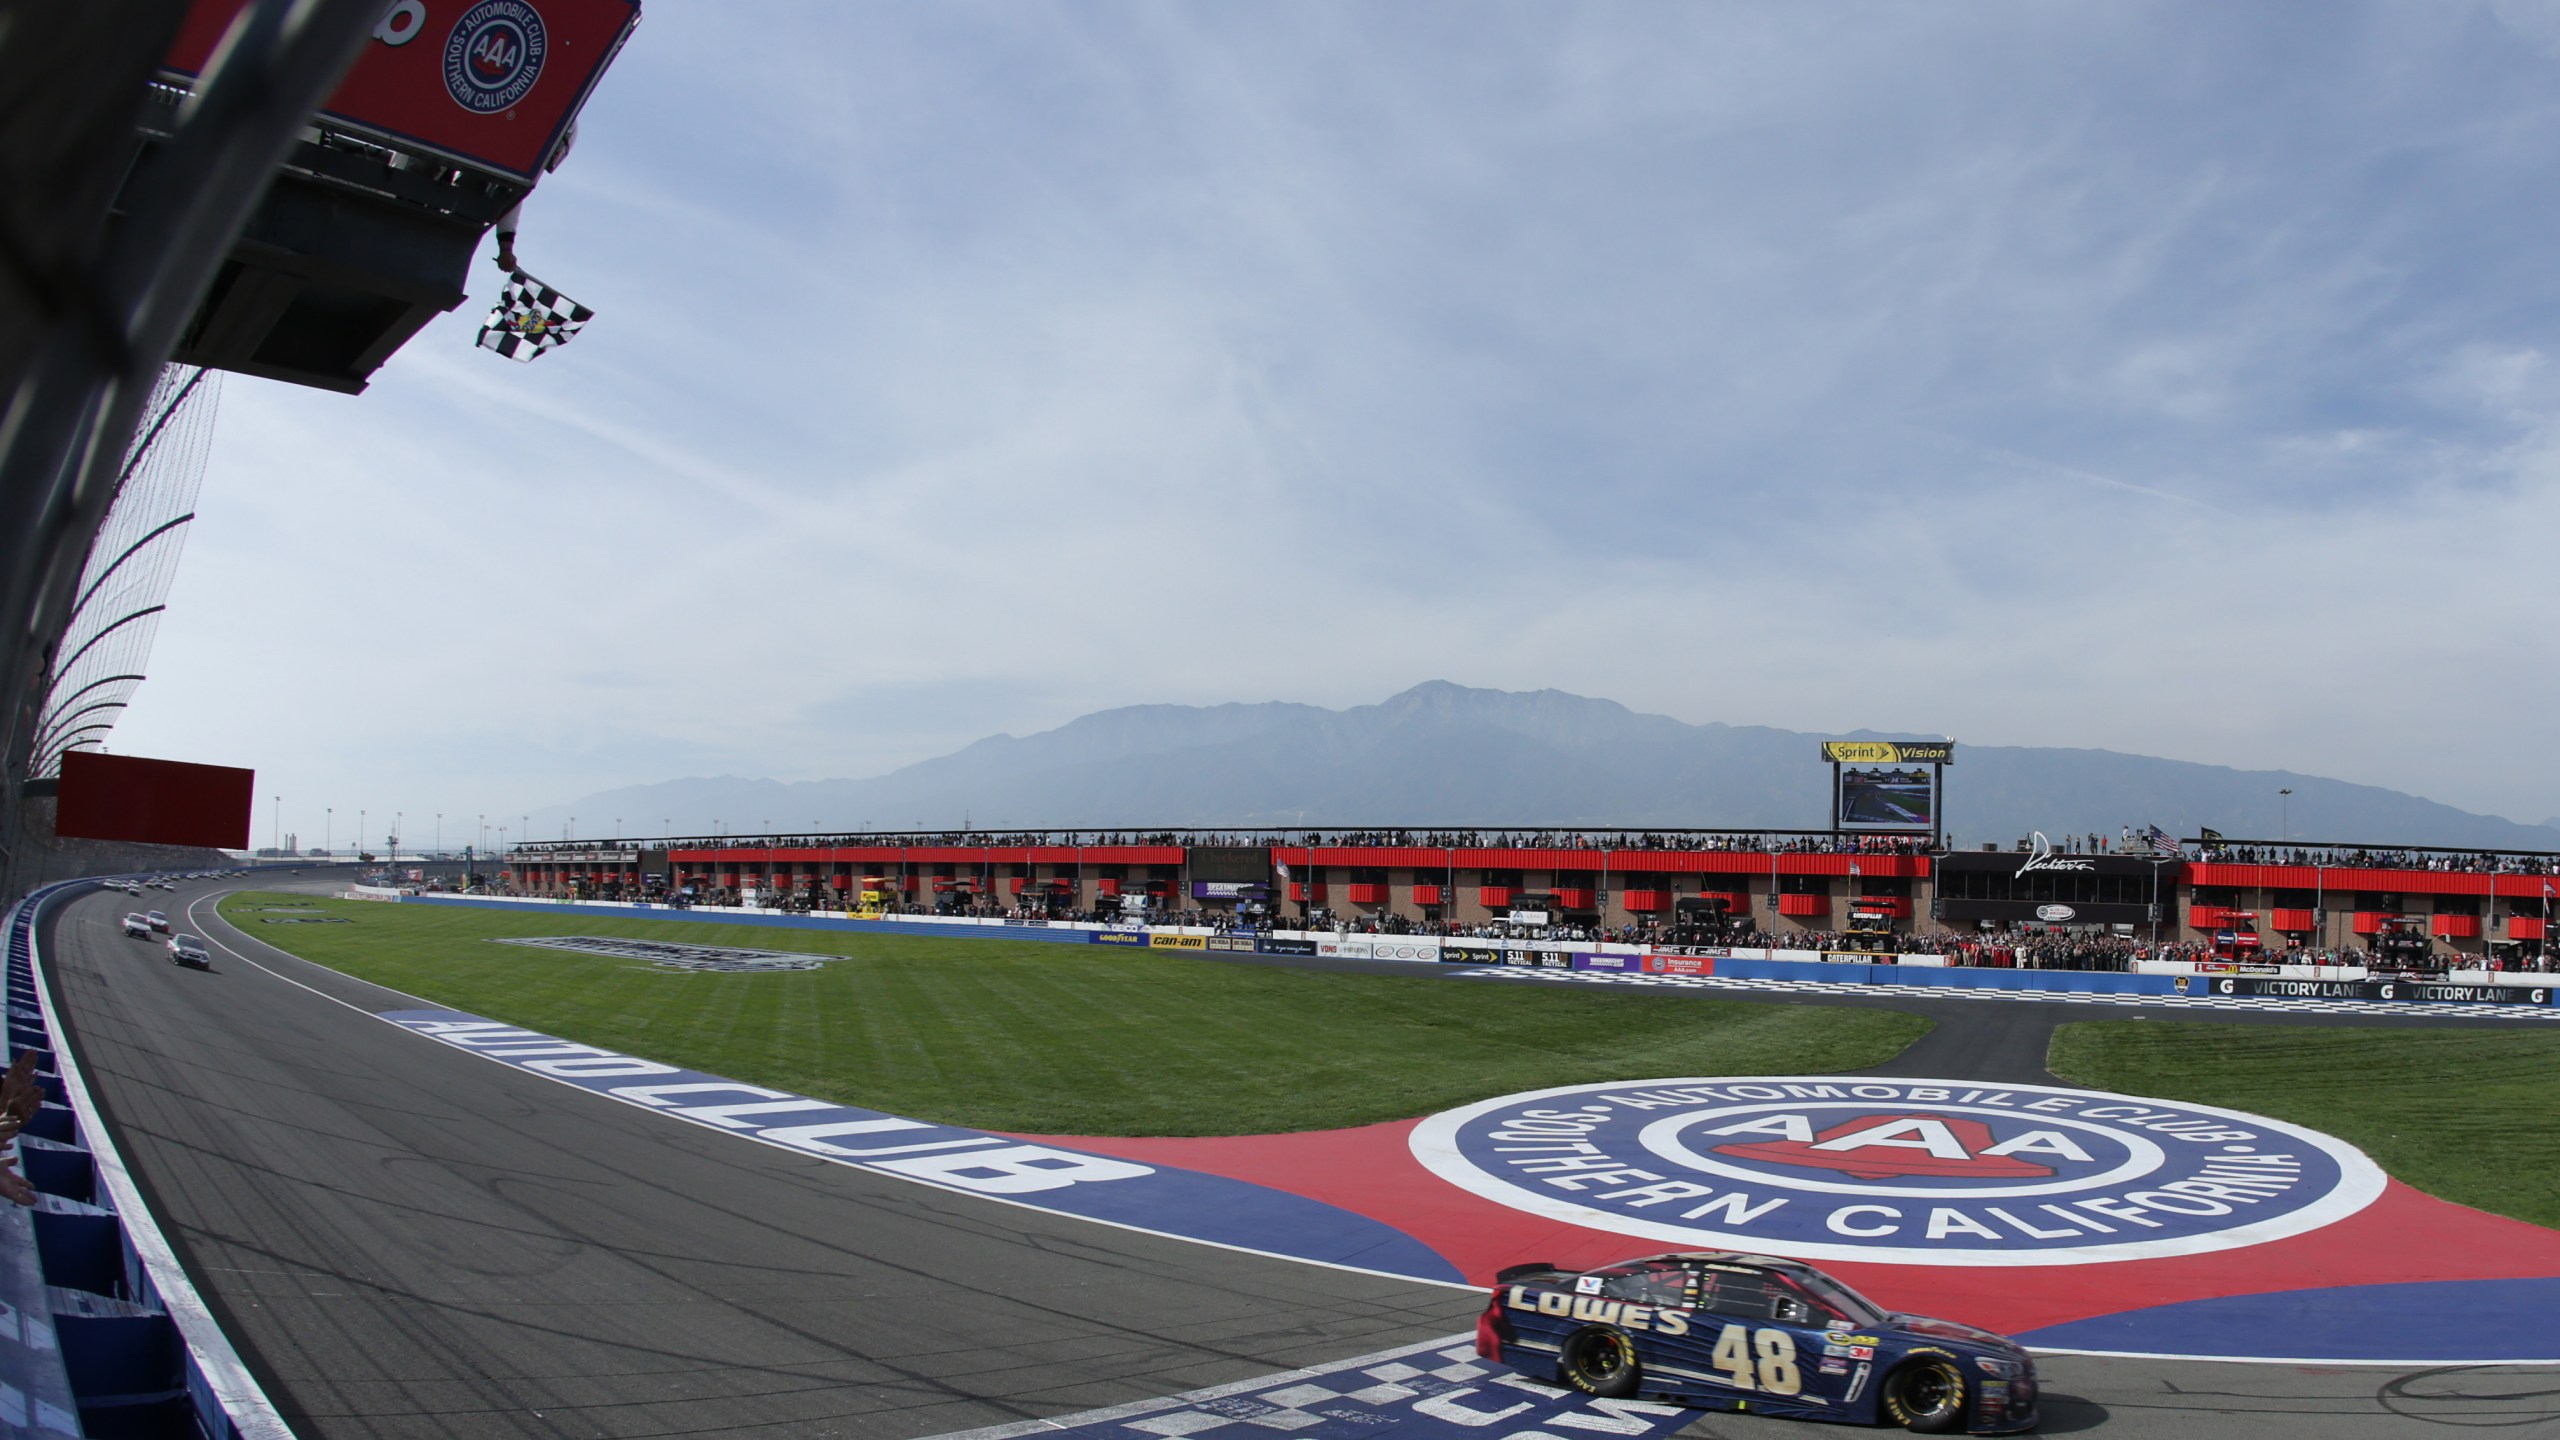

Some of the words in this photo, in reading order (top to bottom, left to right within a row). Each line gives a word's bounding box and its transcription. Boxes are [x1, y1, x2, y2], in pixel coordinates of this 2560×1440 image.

[466, 2, 532, 31] AUTOMOBILE
[527, 24, 541, 55] CLUB
[474, 35, 516, 67] AAA
[448, 35, 475, 103] SOUTHERN
[475, 67, 537, 108] CALIFORNIA
[1838, 747, 1875, 759] Sprint
[1901, 748, 1946, 758] Vision
[1099, 934, 1138, 943] GOODYEAR
[1320, 945, 1337, 953] VONS
[1443, 951, 1461, 960] Sprint
[1472, 953, 1489, 961] Sprint
[1507, 951, 1524, 960] 5.11
[1541, 953, 1559, 962] 5.11
[1668, 958, 1702, 966] Insurance
[1828, 954, 1872, 963] CATERPILLAR
[2220, 979, 2233, 993] G
[2254, 981, 2319, 996] VICTORY
[2323, 983, 2364, 997] LANE
[2381, 985, 2393, 999] G
[2413, 986, 2474, 1000] VICTORY
[2477, 988, 2514, 1001] LANE
[2531, 989, 2544, 1003] G
[395, 1020, 681, 1077] AUTO
[608, 1083, 1156, 1193] CLUB
[1601, 1085, 2086, 1112] AUTOMOBILE
[2077, 1106, 2257, 1142] CLUB
[1701, 1114, 2094, 1162] AAA
[1488, 1109, 1790, 1226] SOUTHERN
[1826, 1154, 2300, 1239] CALIFORNIA
[1508, 1285, 1692, 1335] LOWE'S
[1712, 1323, 1802, 1395] 48
[1568, 1369, 1597, 1392] EAGLE
